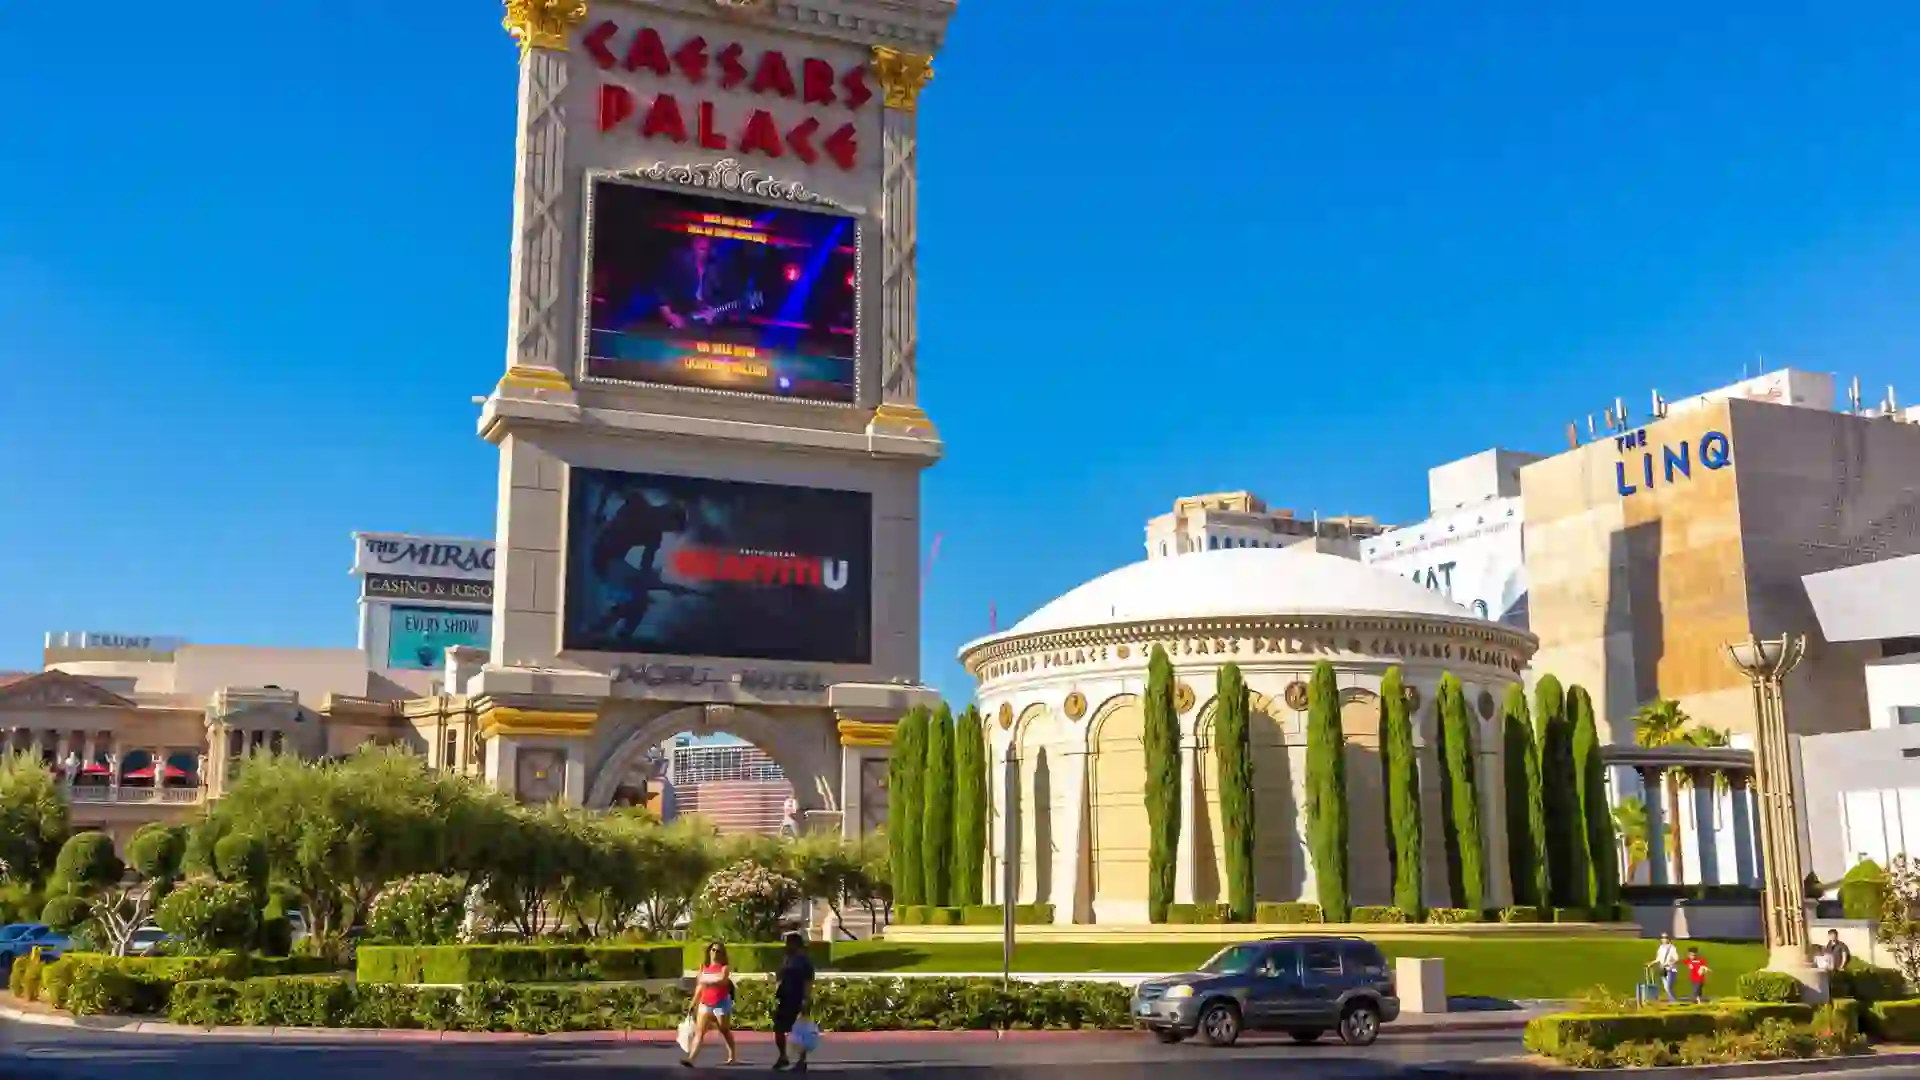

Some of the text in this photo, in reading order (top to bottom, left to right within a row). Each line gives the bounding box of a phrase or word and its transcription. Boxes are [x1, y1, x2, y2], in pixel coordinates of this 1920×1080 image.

[582, 19, 873, 110] CAESARS
[598, 83, 858, 170] PALACE
[1615, 429, 1647, 453] THE
[1616, 431, 1731, 496] LINQ
[366, 540, 400, 553] THE
[369, 579, 430, 594] CASINO
[435, 584, 445, 595] &
[823, 558, 848, 590] U
[444, 618, 479, 633] SHOW
[1043, 647, 1109, 669] PALACE
[1142, 635, 1240, 656] CESARS
